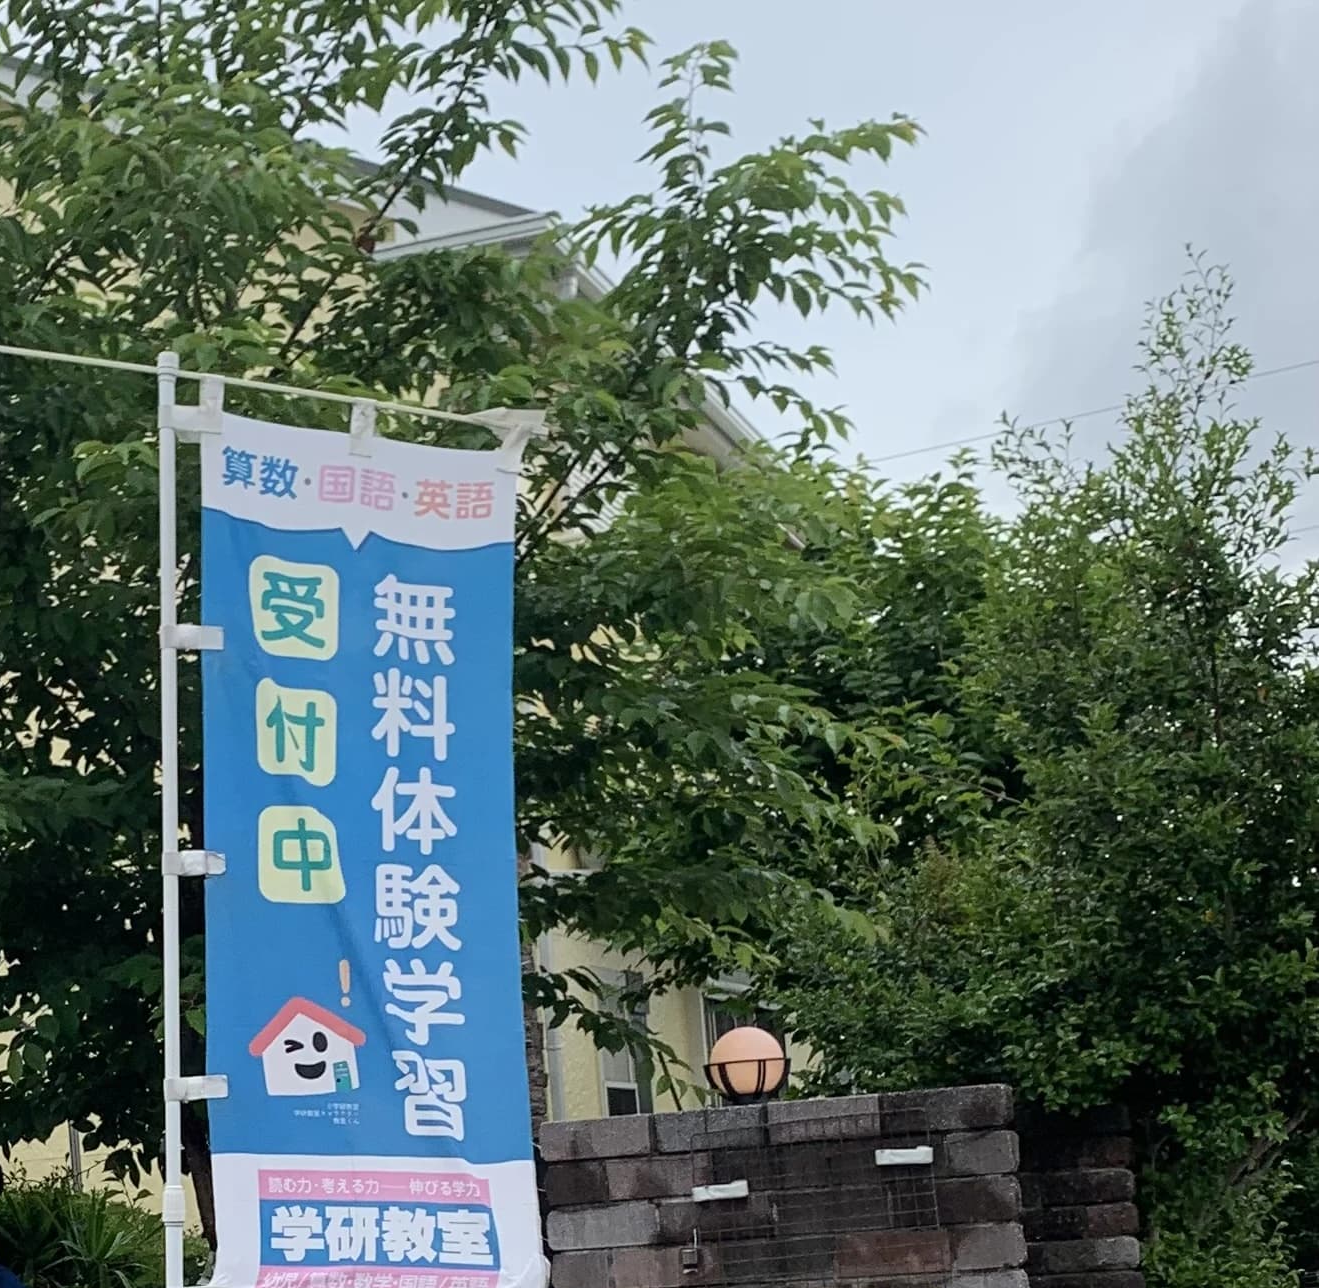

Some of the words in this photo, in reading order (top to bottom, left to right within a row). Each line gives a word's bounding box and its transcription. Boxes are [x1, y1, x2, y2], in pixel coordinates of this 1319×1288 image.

[222, 445, 495, 520] 算数・国語・英語
[261, 571, 333, 892] 受付中
[371, 573, 468, 1142] 無料体験学習
[270, 1205, 494, 1265] 学研教室
